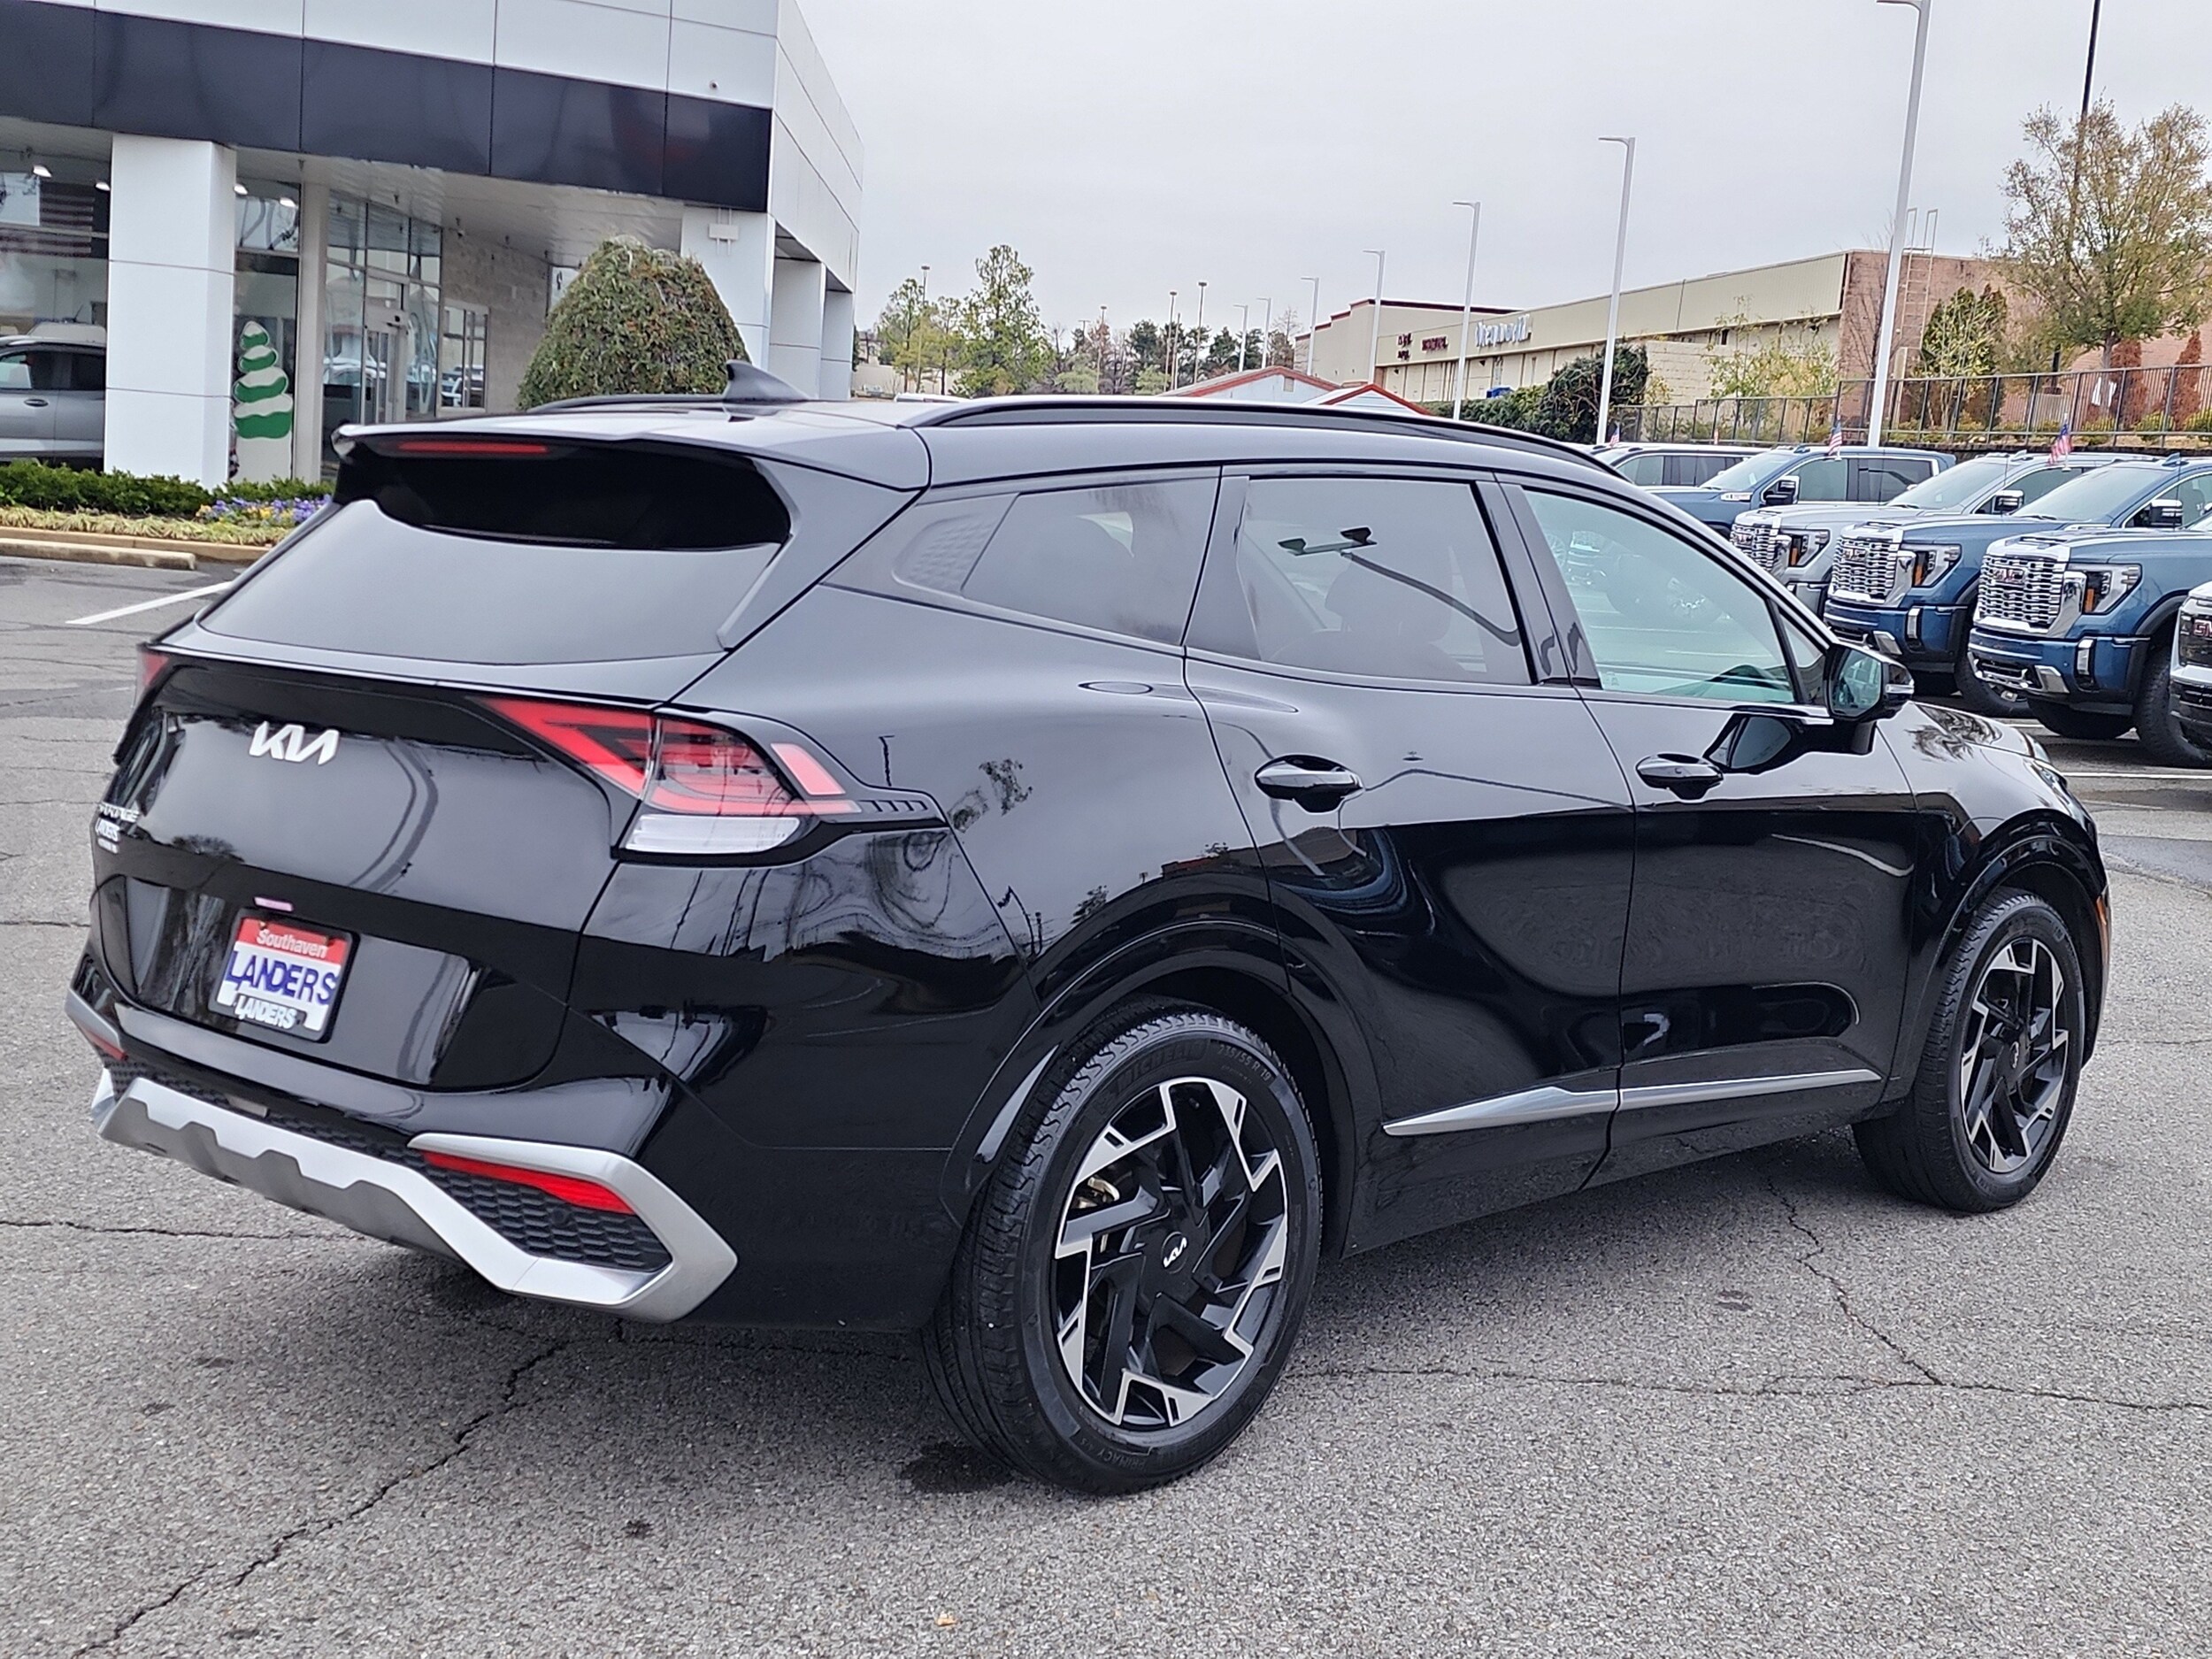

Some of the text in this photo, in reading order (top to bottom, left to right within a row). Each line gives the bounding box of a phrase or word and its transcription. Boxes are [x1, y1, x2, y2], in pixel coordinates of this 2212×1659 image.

[249, 720, 340, 765] KIA
[257, 929, 328, 959] Southaven
[225, 949, 341, 1005] LANDERS
[234, 995, 298, 1030] LANDERS
[1217, 1044, 1253, 1066] 235/55
[1251, 1060, 1261, 1071] R
[1260, 1068, 1271, 1081] 19
